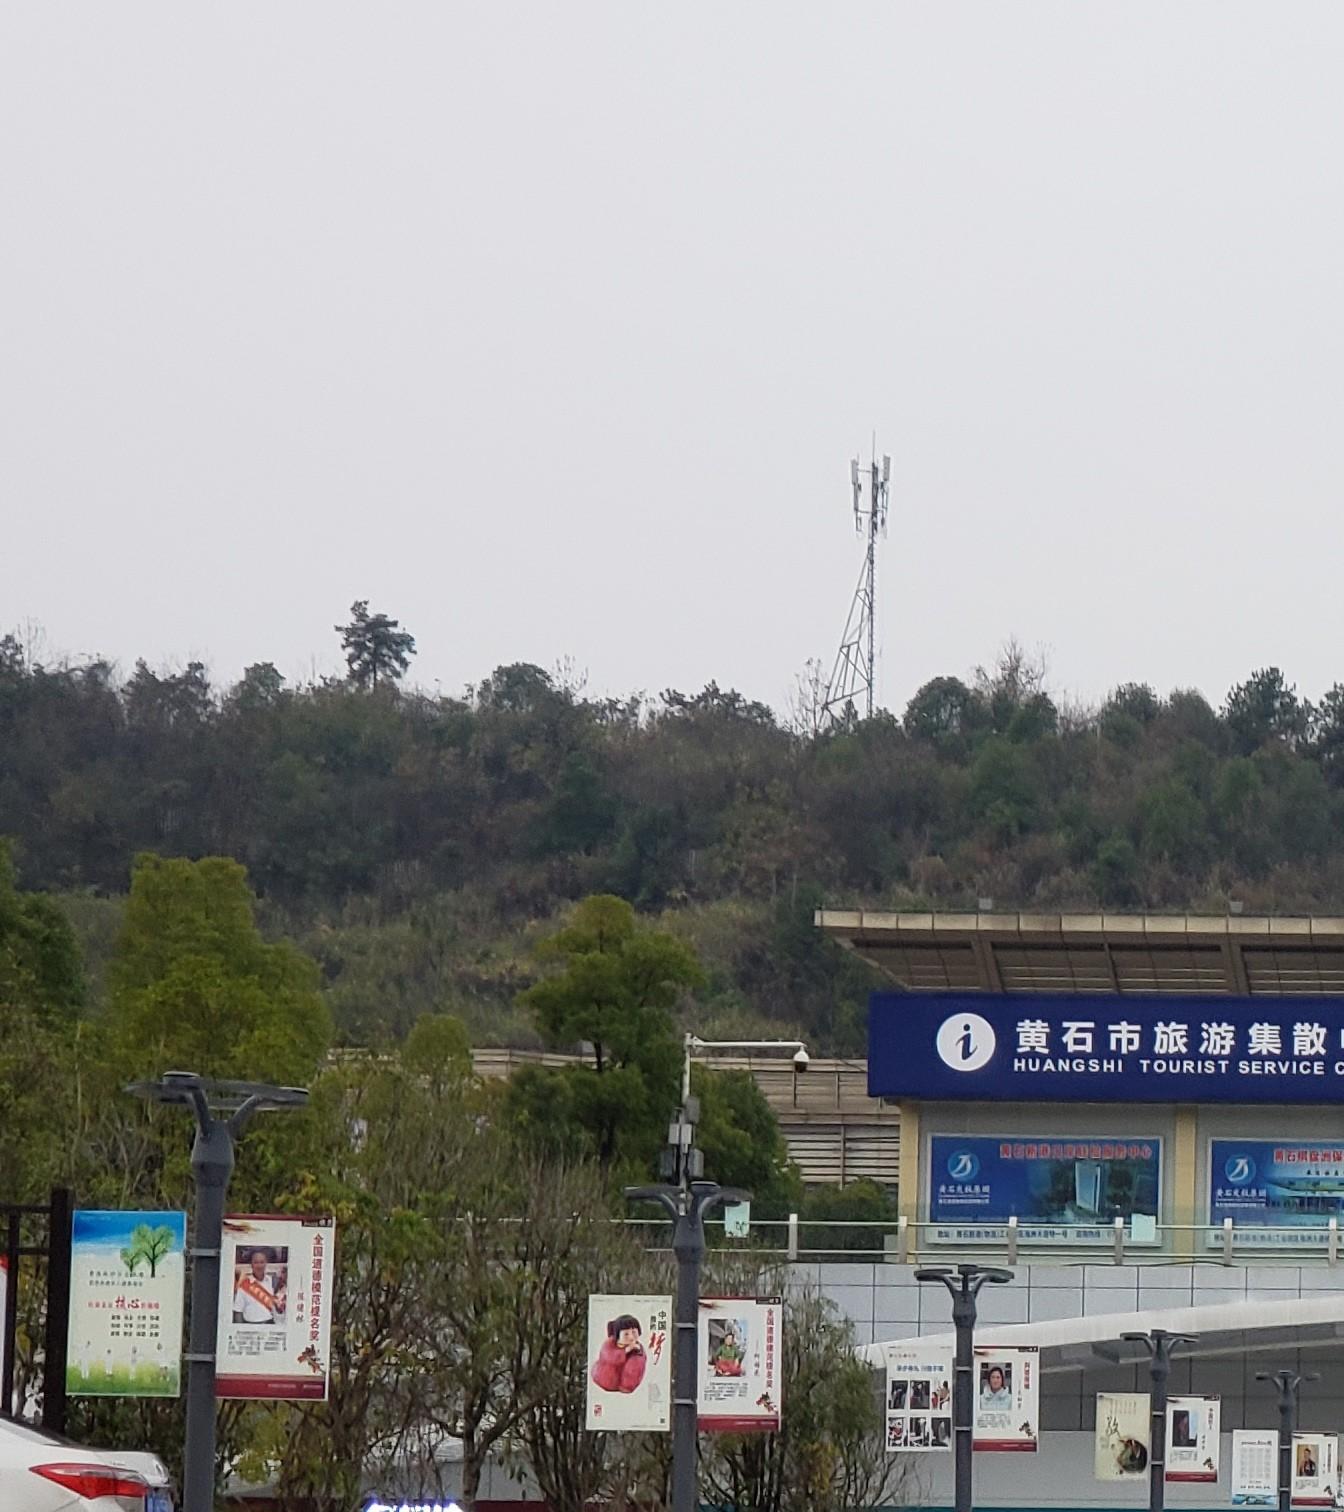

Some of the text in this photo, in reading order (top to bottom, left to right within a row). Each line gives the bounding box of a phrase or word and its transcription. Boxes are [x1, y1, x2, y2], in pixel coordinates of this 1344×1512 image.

[1013, 1057, 1124, 1074] HUANGSHI
[1140, 1058, 1230, 1075] TOURIST
[1238, 1059, 1326, 1076] SERVICE
[309, 1232, 325, 1342] 全国道德模范提名奖
